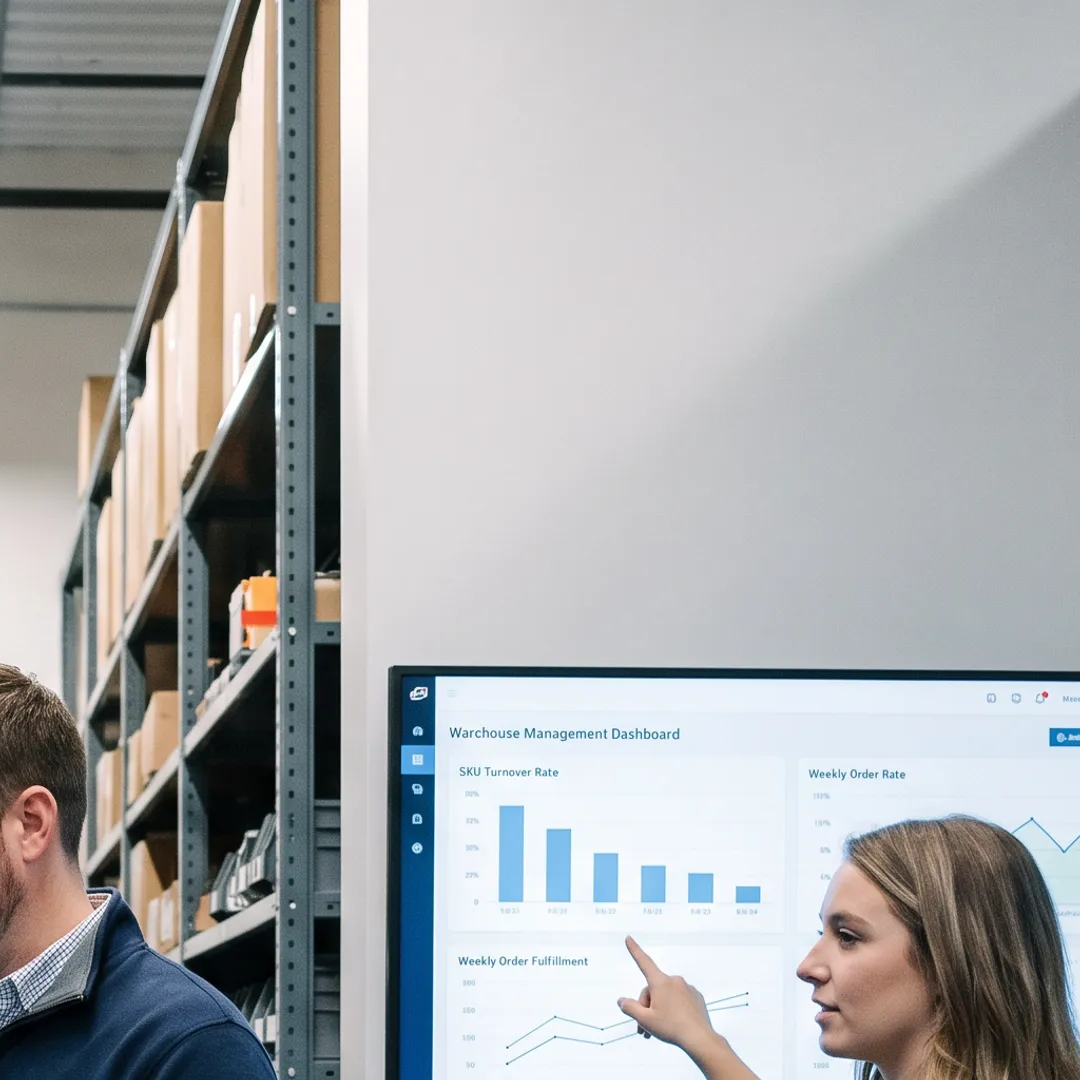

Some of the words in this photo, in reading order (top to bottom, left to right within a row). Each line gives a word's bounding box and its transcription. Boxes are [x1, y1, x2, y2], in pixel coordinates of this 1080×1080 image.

[524, 727, 608, 742] Management
[611, 727, 680, 741] Dashboard
[459, 766, 481, 777] SKU
[483, 766, 532, 778] Turnover
[534, 767, 560, 778] Rate
[808, 768, 847, 781] Weekly
[849, 768, 879, 780] Order
[882, 769, 906, 780] Rate
[457, 955, 497, 969] Weekly
[498, 955, 529, 967] Order
[531, 955, 589, 967] Fulfillment
